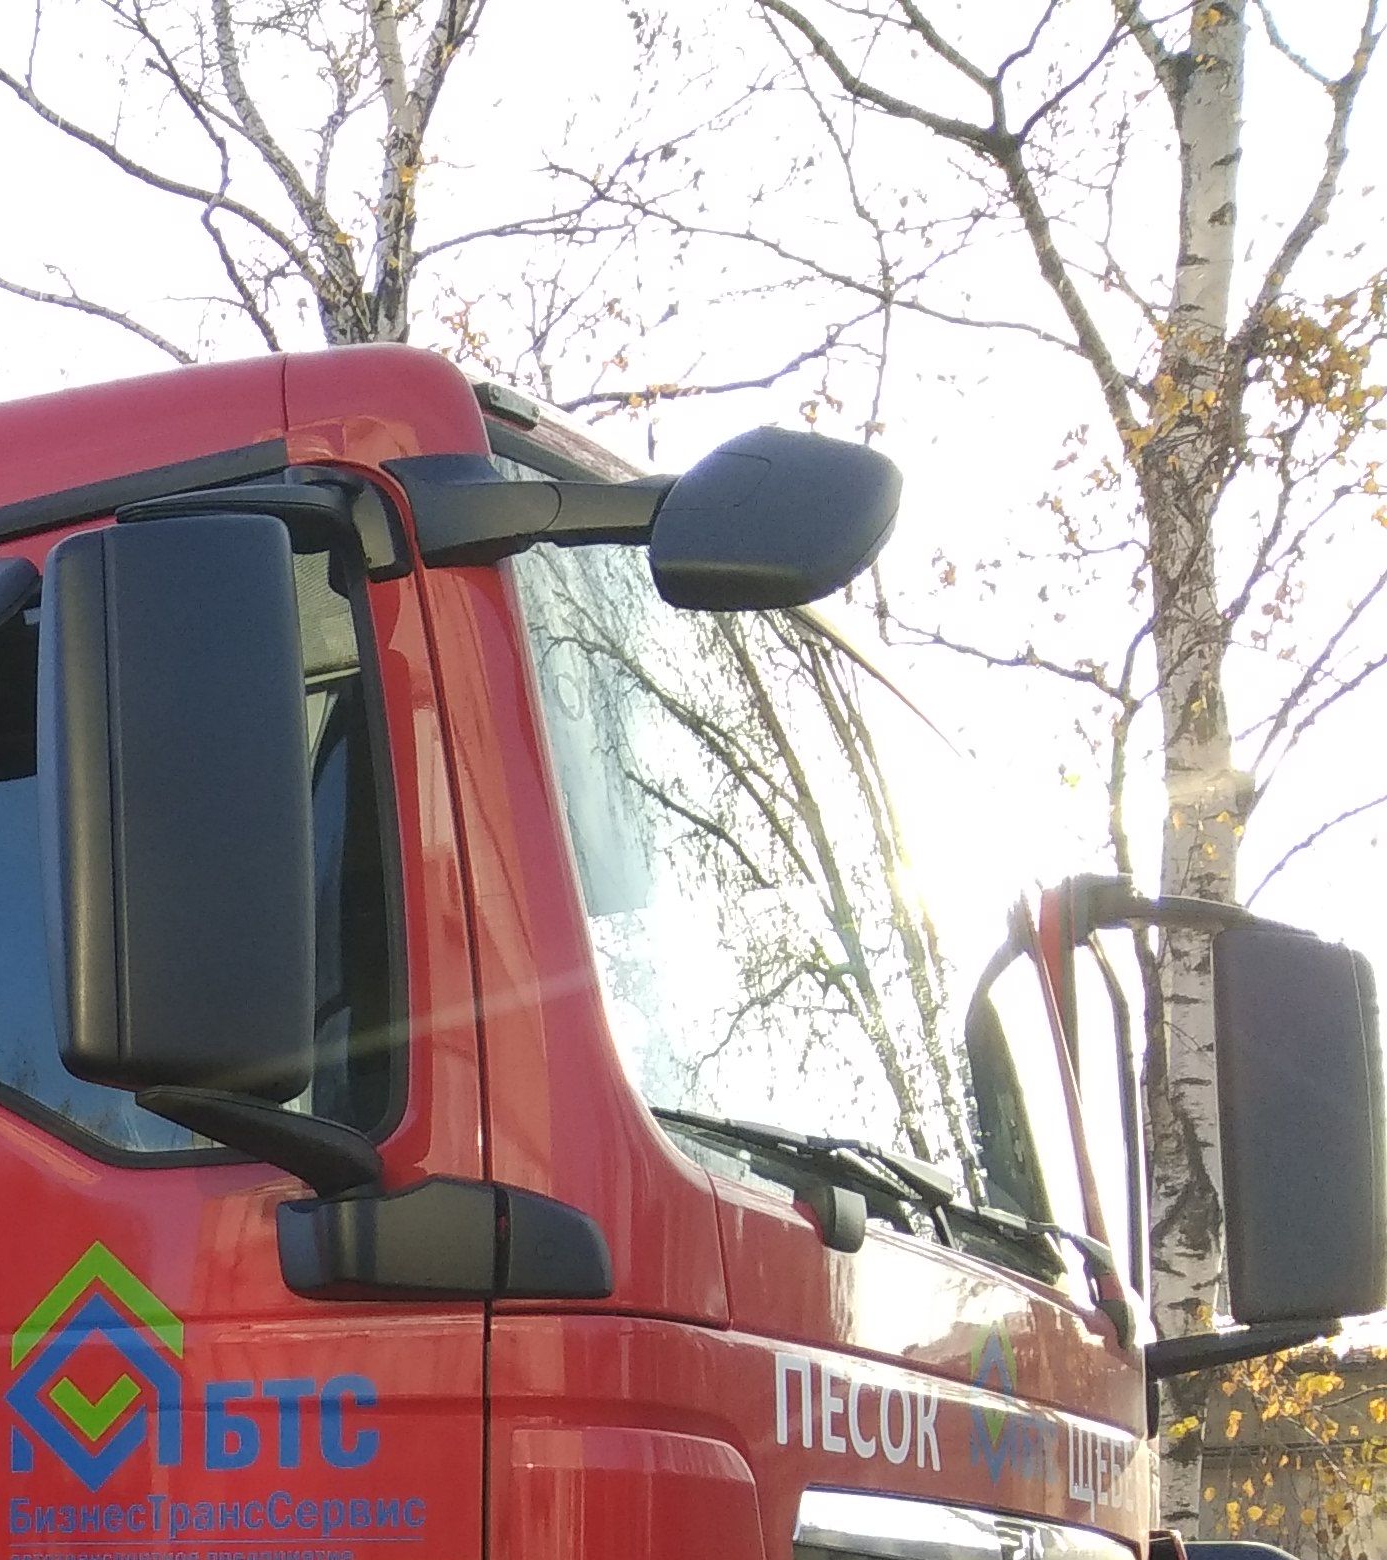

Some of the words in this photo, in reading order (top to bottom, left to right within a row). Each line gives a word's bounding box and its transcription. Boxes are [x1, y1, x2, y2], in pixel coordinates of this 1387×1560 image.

[204, 1372, 381, 1472] БТС
[774, 1350, 942, 1473] ПЕСОК
[8, 1490, 428, 1541] БизнесТрансСервис
